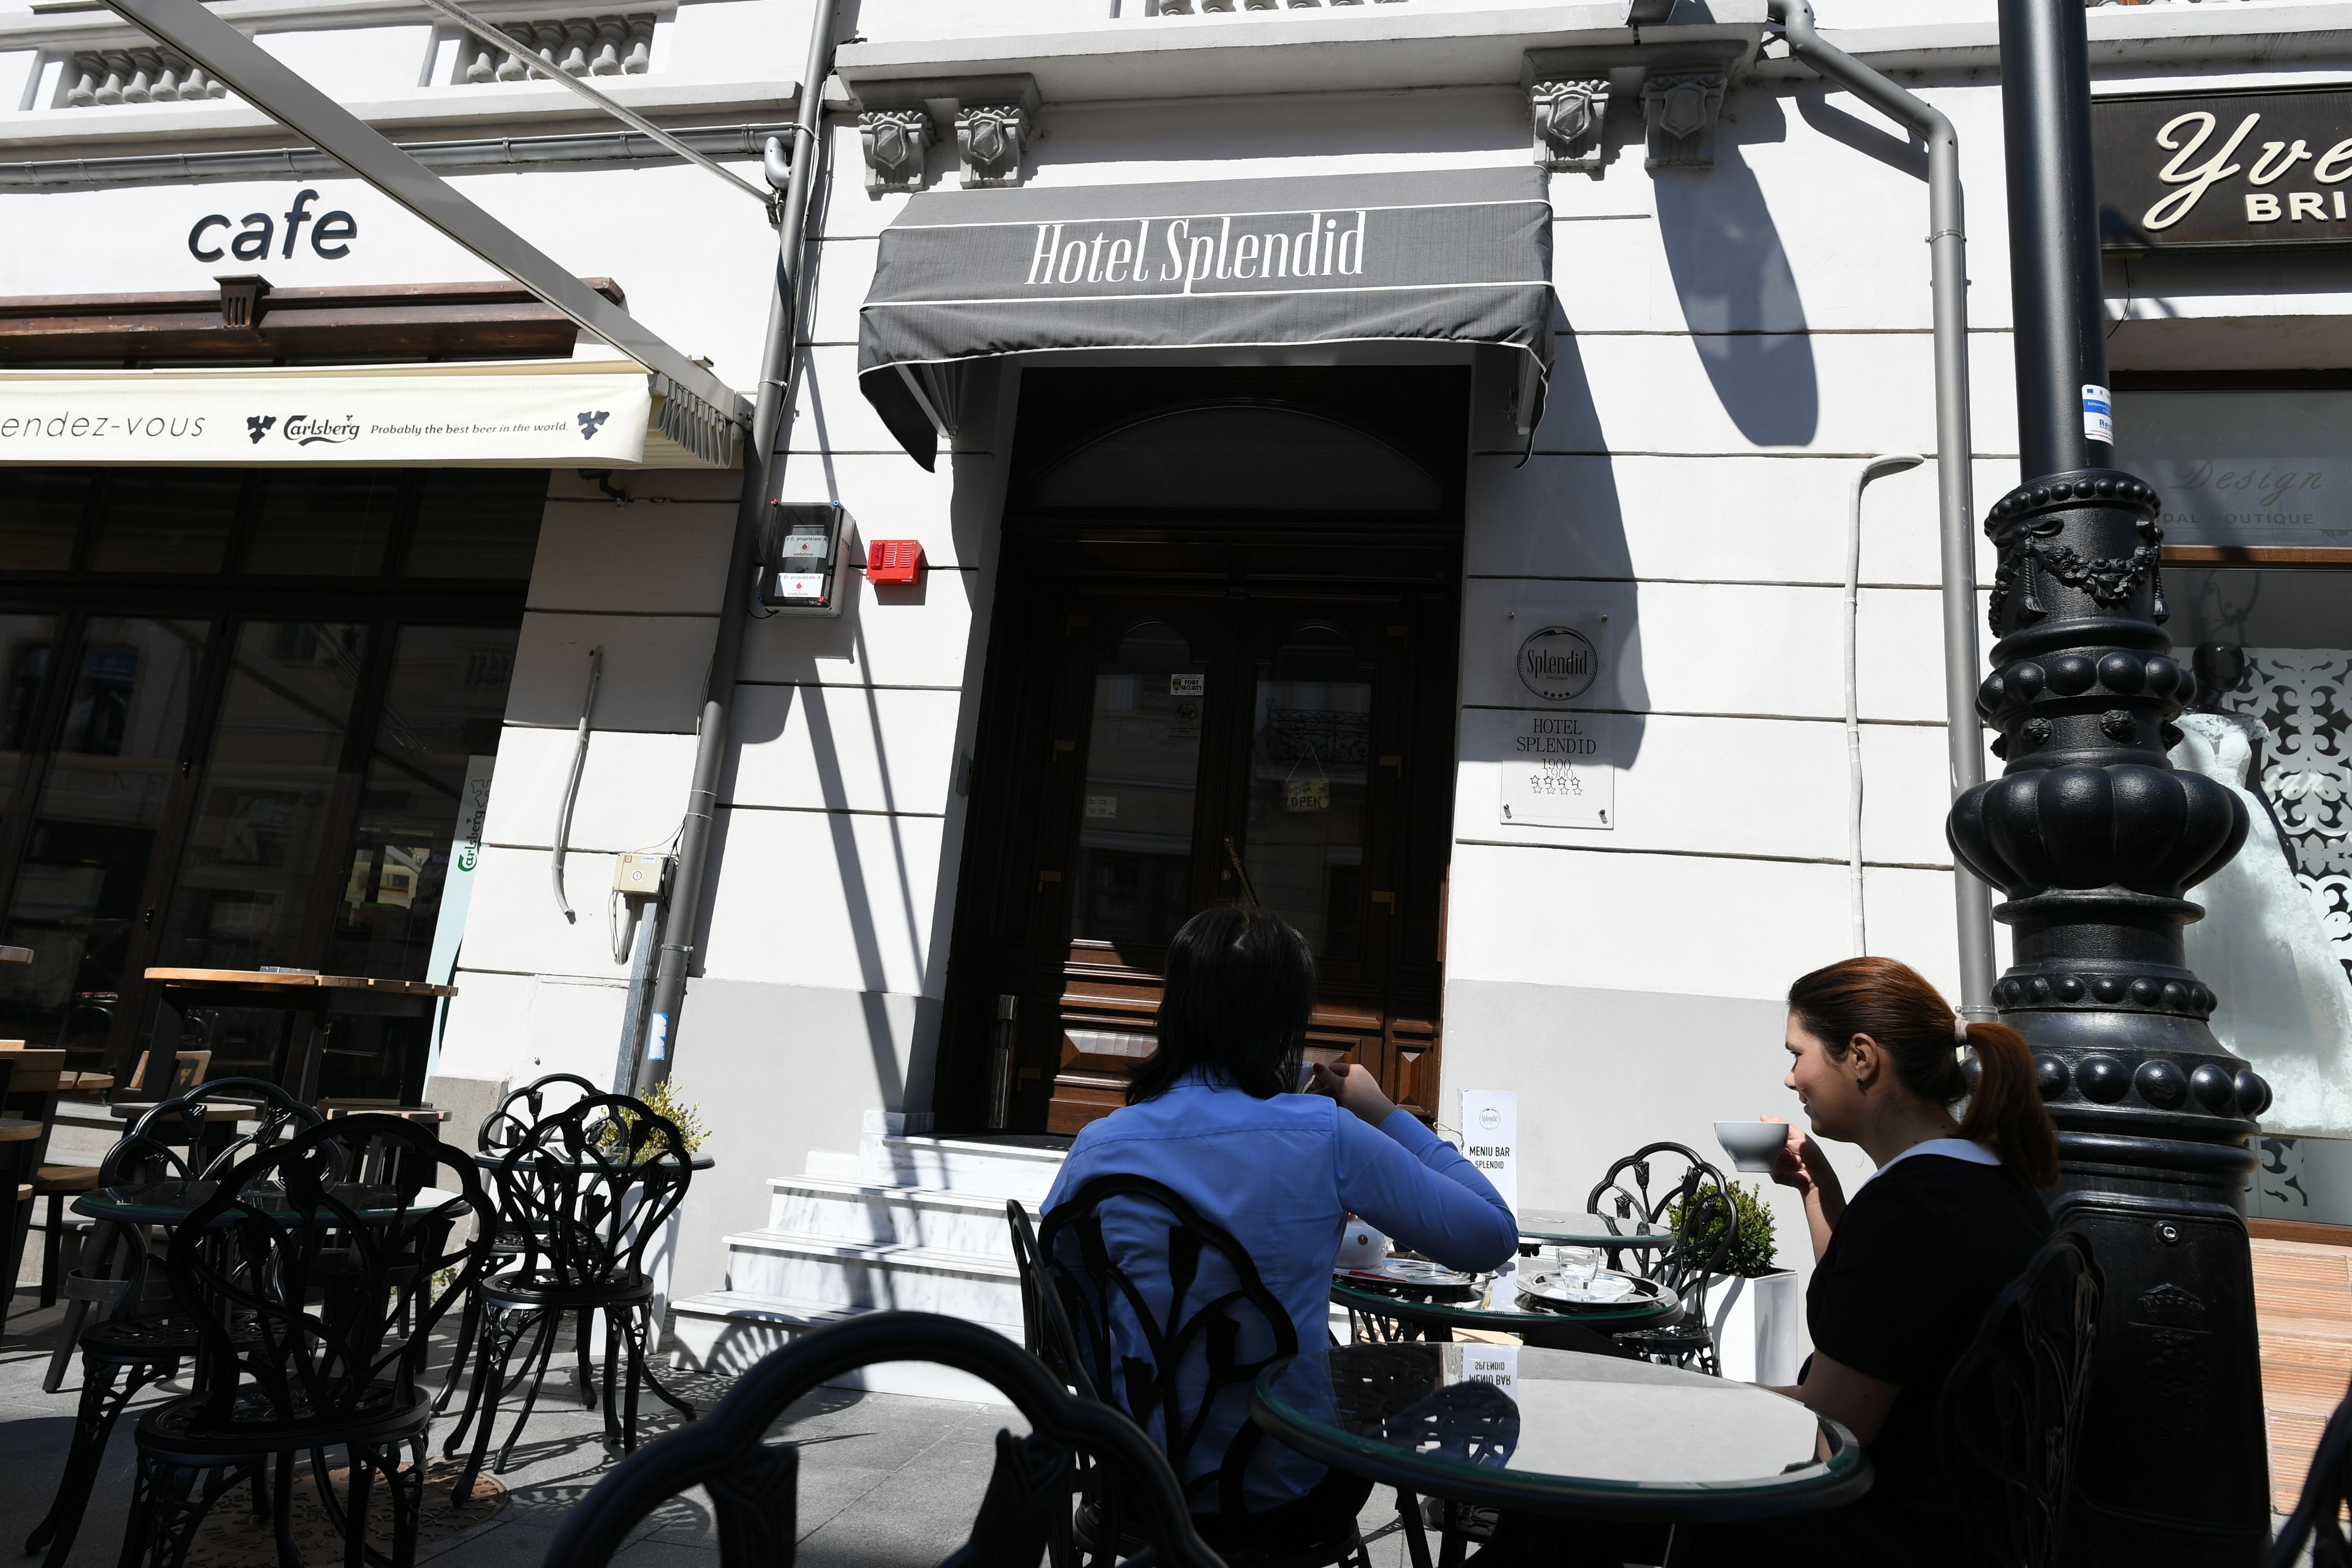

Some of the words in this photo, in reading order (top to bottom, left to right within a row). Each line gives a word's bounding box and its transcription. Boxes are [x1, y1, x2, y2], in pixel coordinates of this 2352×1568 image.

[2245, 191, 2346, 223] BRI
[188, 189, 358, 264] cafe
[1023, 220, 1150, 285] Hotel
[1159, 211, 1366, 295] Splendid
[1, 411, 205, 437] endez-vous
[283, 415, 360, 444] Carlsberg
[370, 424, 422, 436] Probably
[425, 424, 443, 434] the
[446, 424, 470, 434] best
[472, 424, 497, 433] beer
[513, 423, 530, 432] the
[534, 421, 568, 431] world.
[2167, 459, 2323, 507] Design
[2211, 513, 2315, 524] BOUTIQUE
[1527, 649, 1587, 679] Splendid
[1533, 718, 1583, 736] HOTEL
[1517, 736, 1597, 755] SPLENDID
[1542, 758, 1572, 771] 1900
[1291, 796, 1322, 807] OPEN
[458, 810, 486, 872] Carlsberg
[1469, 1146, 1493, 1157] MENIU
[1495, 1147, 1510, 1157] BAR
[1475, 1160, 1504, 1169] SPLENDID
